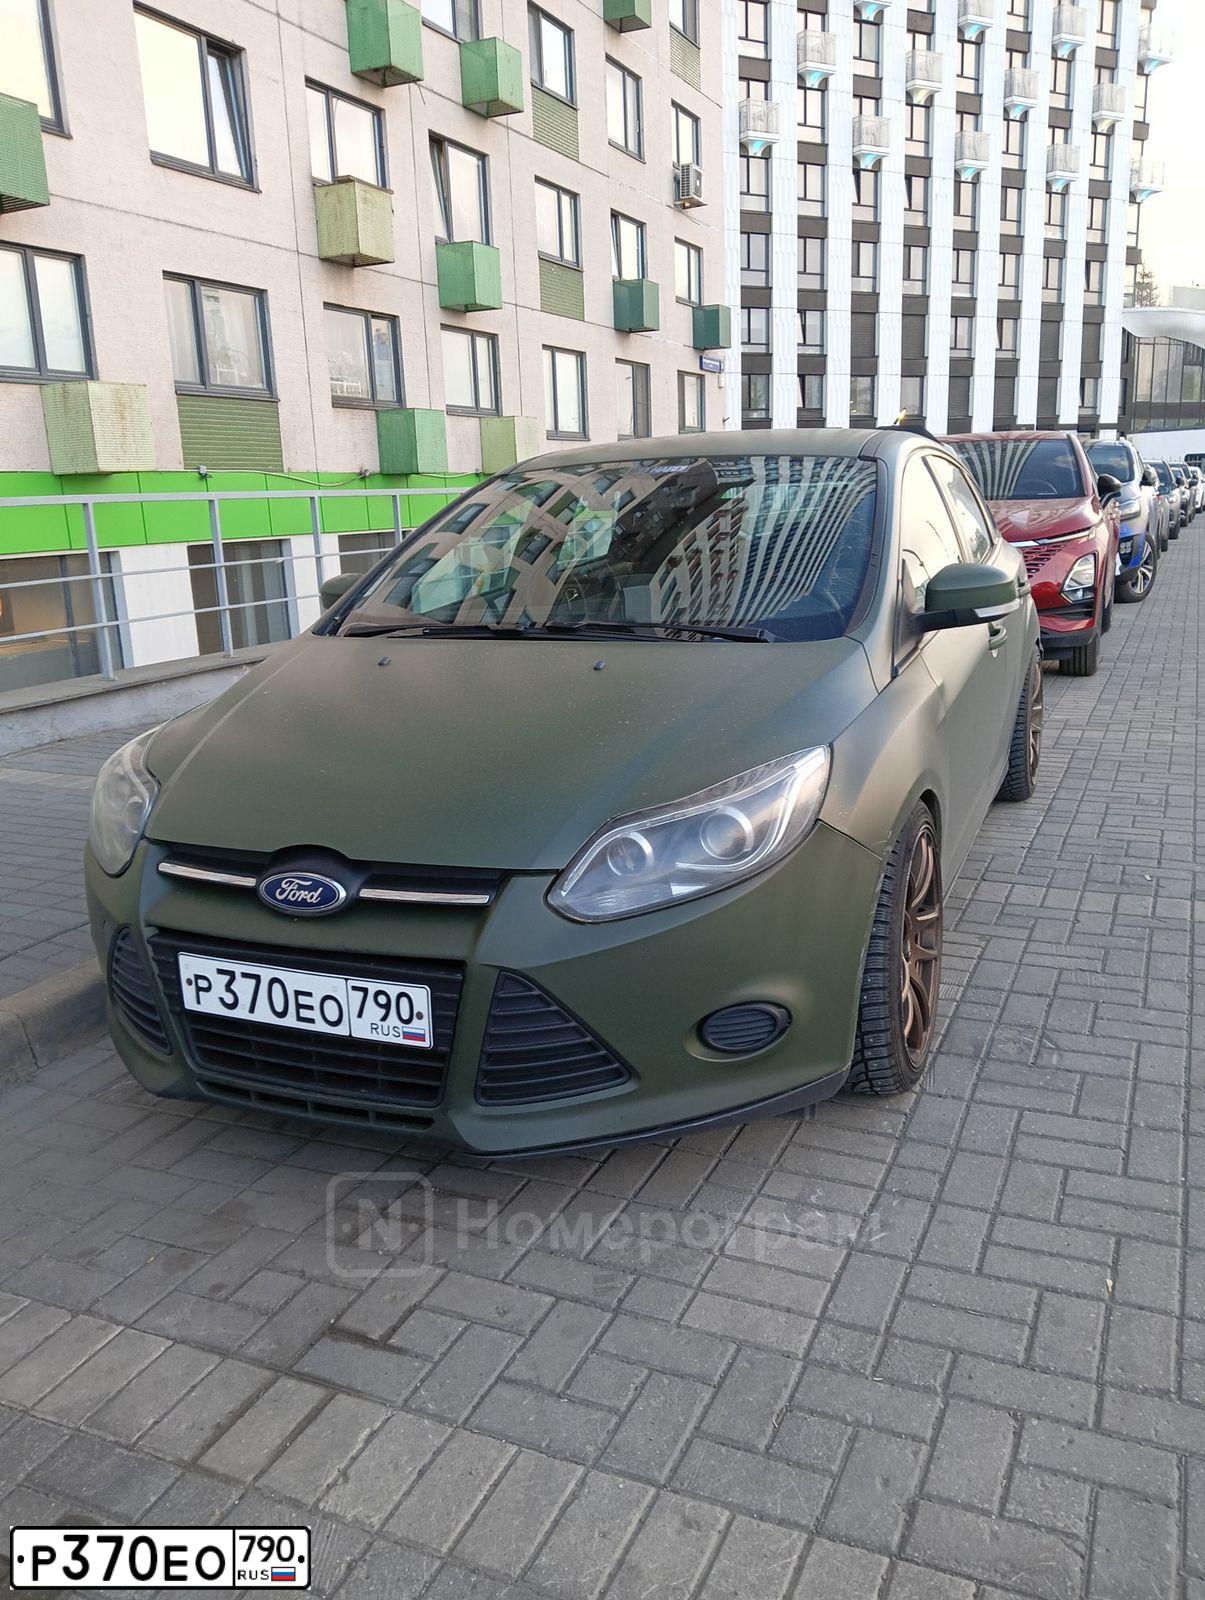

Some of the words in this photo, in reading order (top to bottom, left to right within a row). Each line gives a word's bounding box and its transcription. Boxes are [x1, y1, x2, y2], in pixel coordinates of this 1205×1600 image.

[275, 878, 323, 903] Ford
[350, 986, 415, 1025] 790
[370, 1022, 401, 1038] RUS
